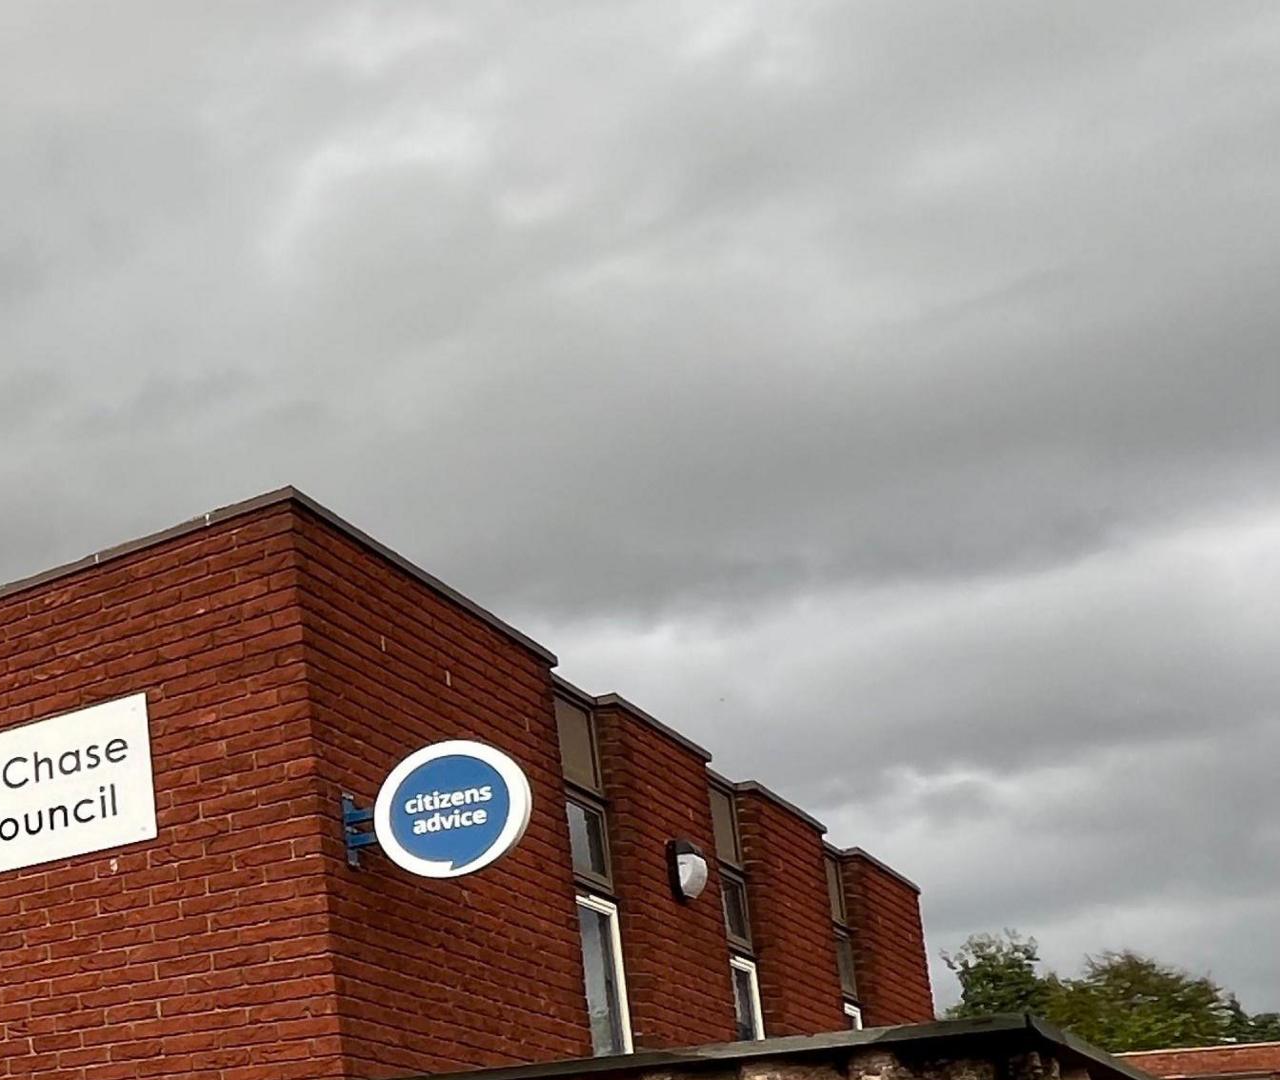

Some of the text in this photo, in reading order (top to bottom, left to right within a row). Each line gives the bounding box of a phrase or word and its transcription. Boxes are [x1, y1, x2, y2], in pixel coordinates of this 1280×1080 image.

[3, 738, 128, 788] Chase
[404, 785, 492, 814] citizens
[413, 808, 487, 835] advice
